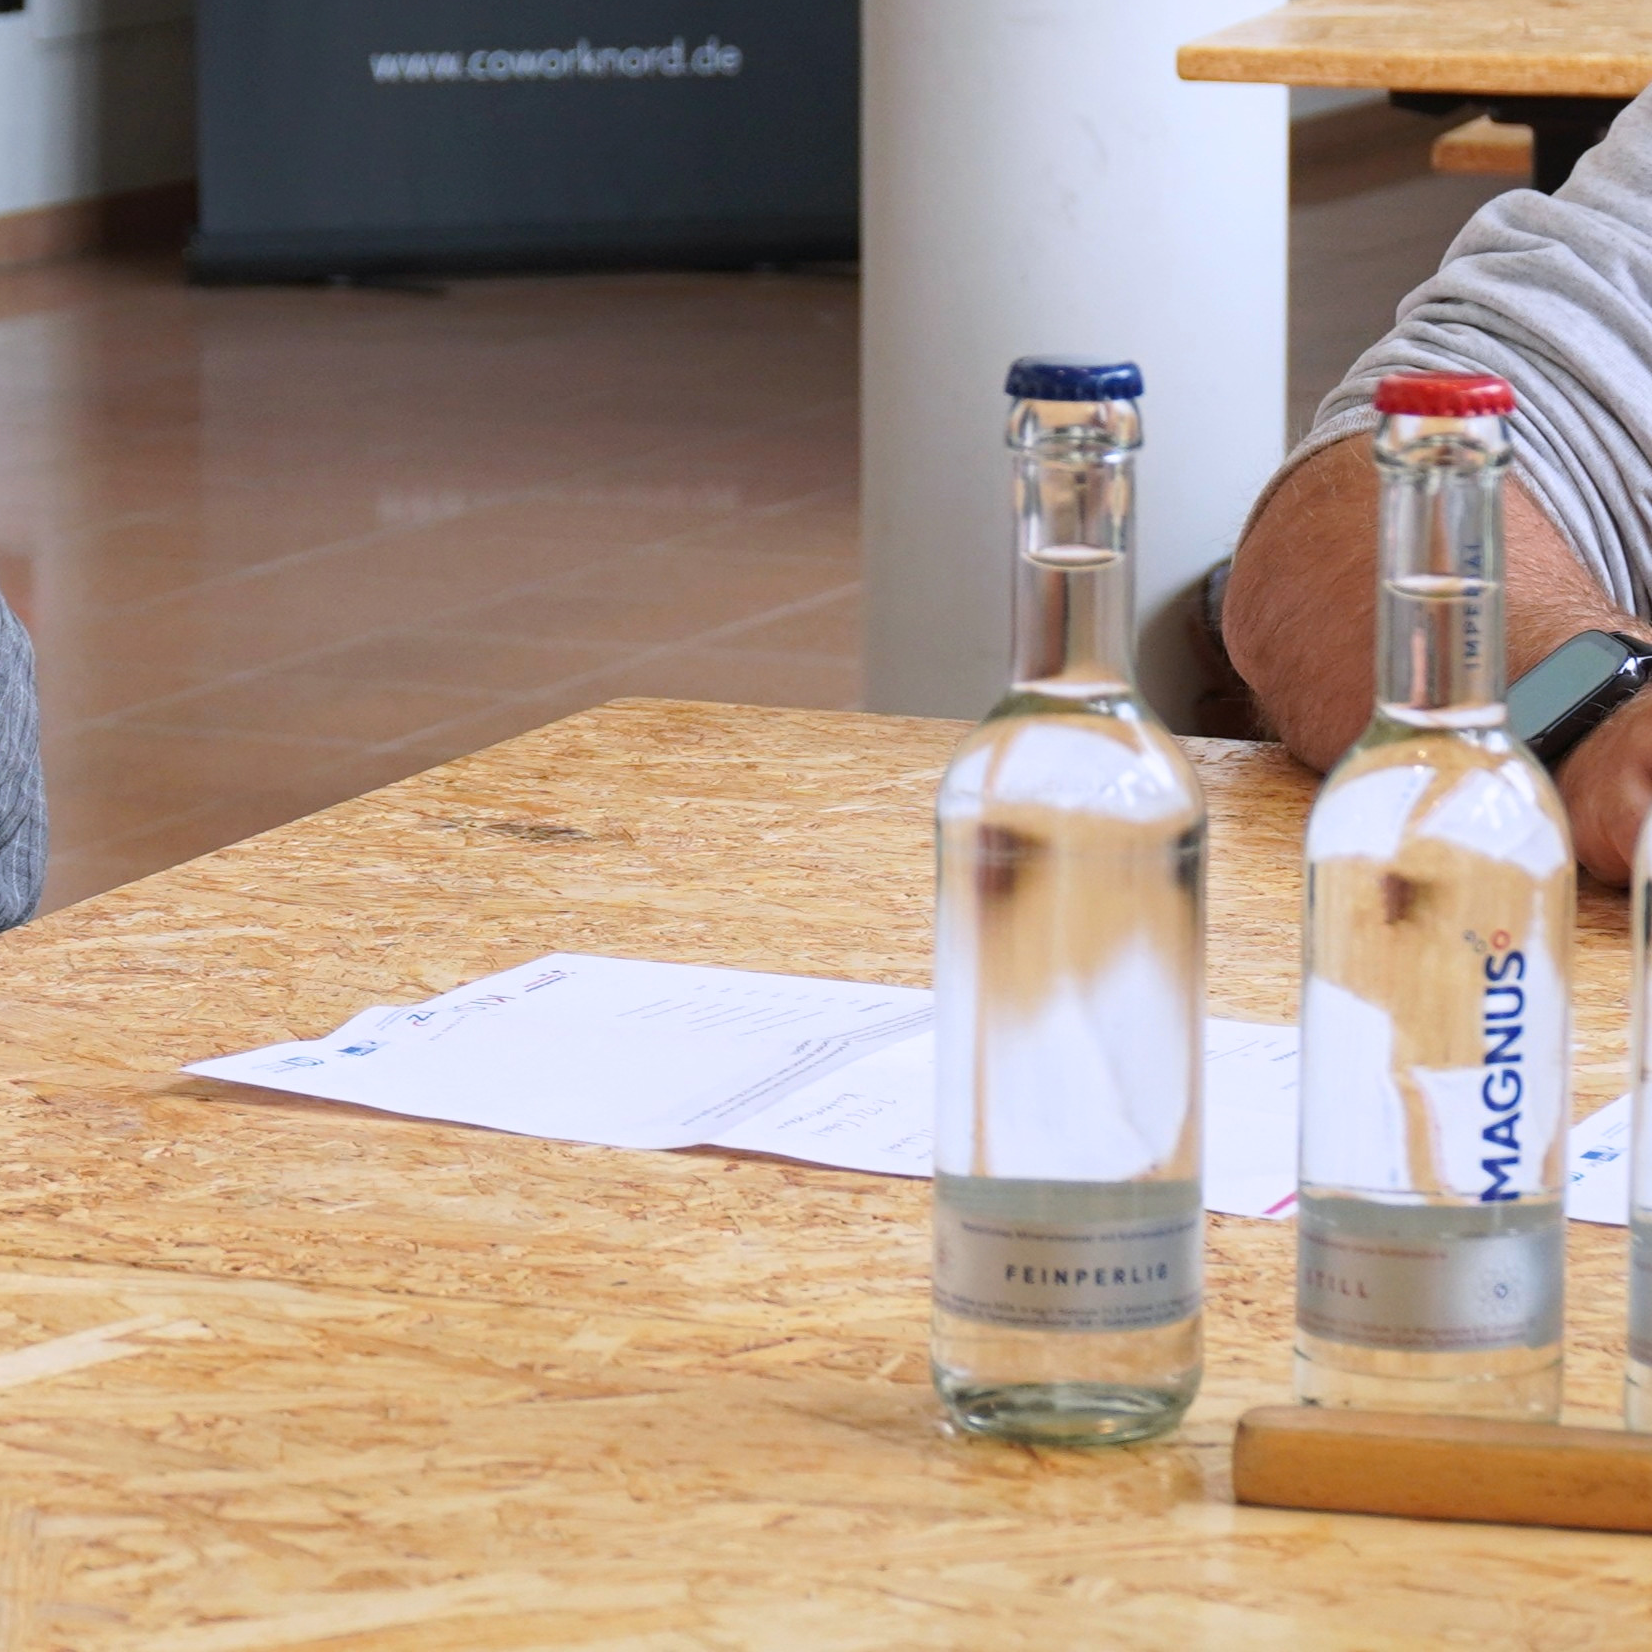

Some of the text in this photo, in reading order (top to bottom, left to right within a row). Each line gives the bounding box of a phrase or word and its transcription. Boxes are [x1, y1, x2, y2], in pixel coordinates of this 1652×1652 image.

[368, 34, 745, 84] www.coworknord.de
[1480, 949, 1527, 1204] MAGNUS
[1005, 1262, 1170, 1288] FEINPERLIG
